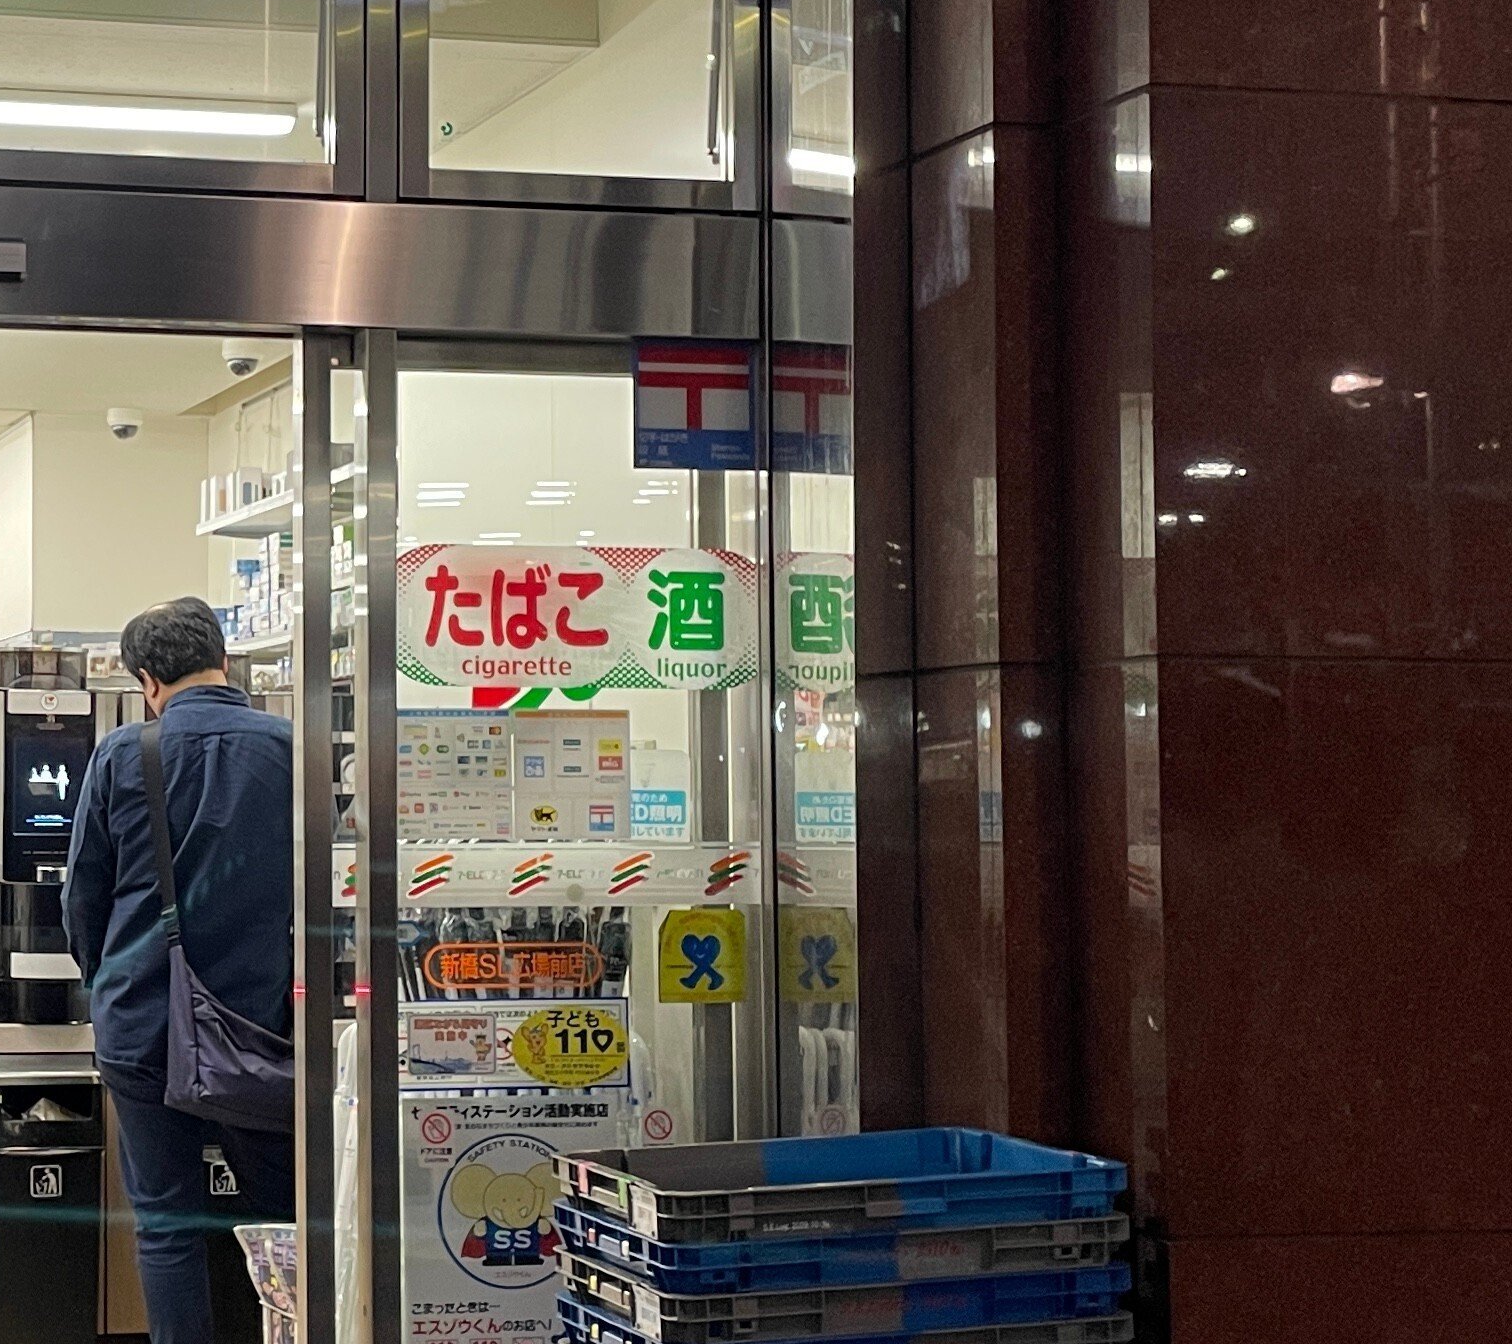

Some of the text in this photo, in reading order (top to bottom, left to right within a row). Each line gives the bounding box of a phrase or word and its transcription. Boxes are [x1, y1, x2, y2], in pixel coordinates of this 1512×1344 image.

[425, 562, 726, 651] たばこ 酒
[461, 656, 727, 680] cigarette liquor
[546, 1010, 600, 1028] 子ども
[467, 1139, 506, 1163] SAFETY
